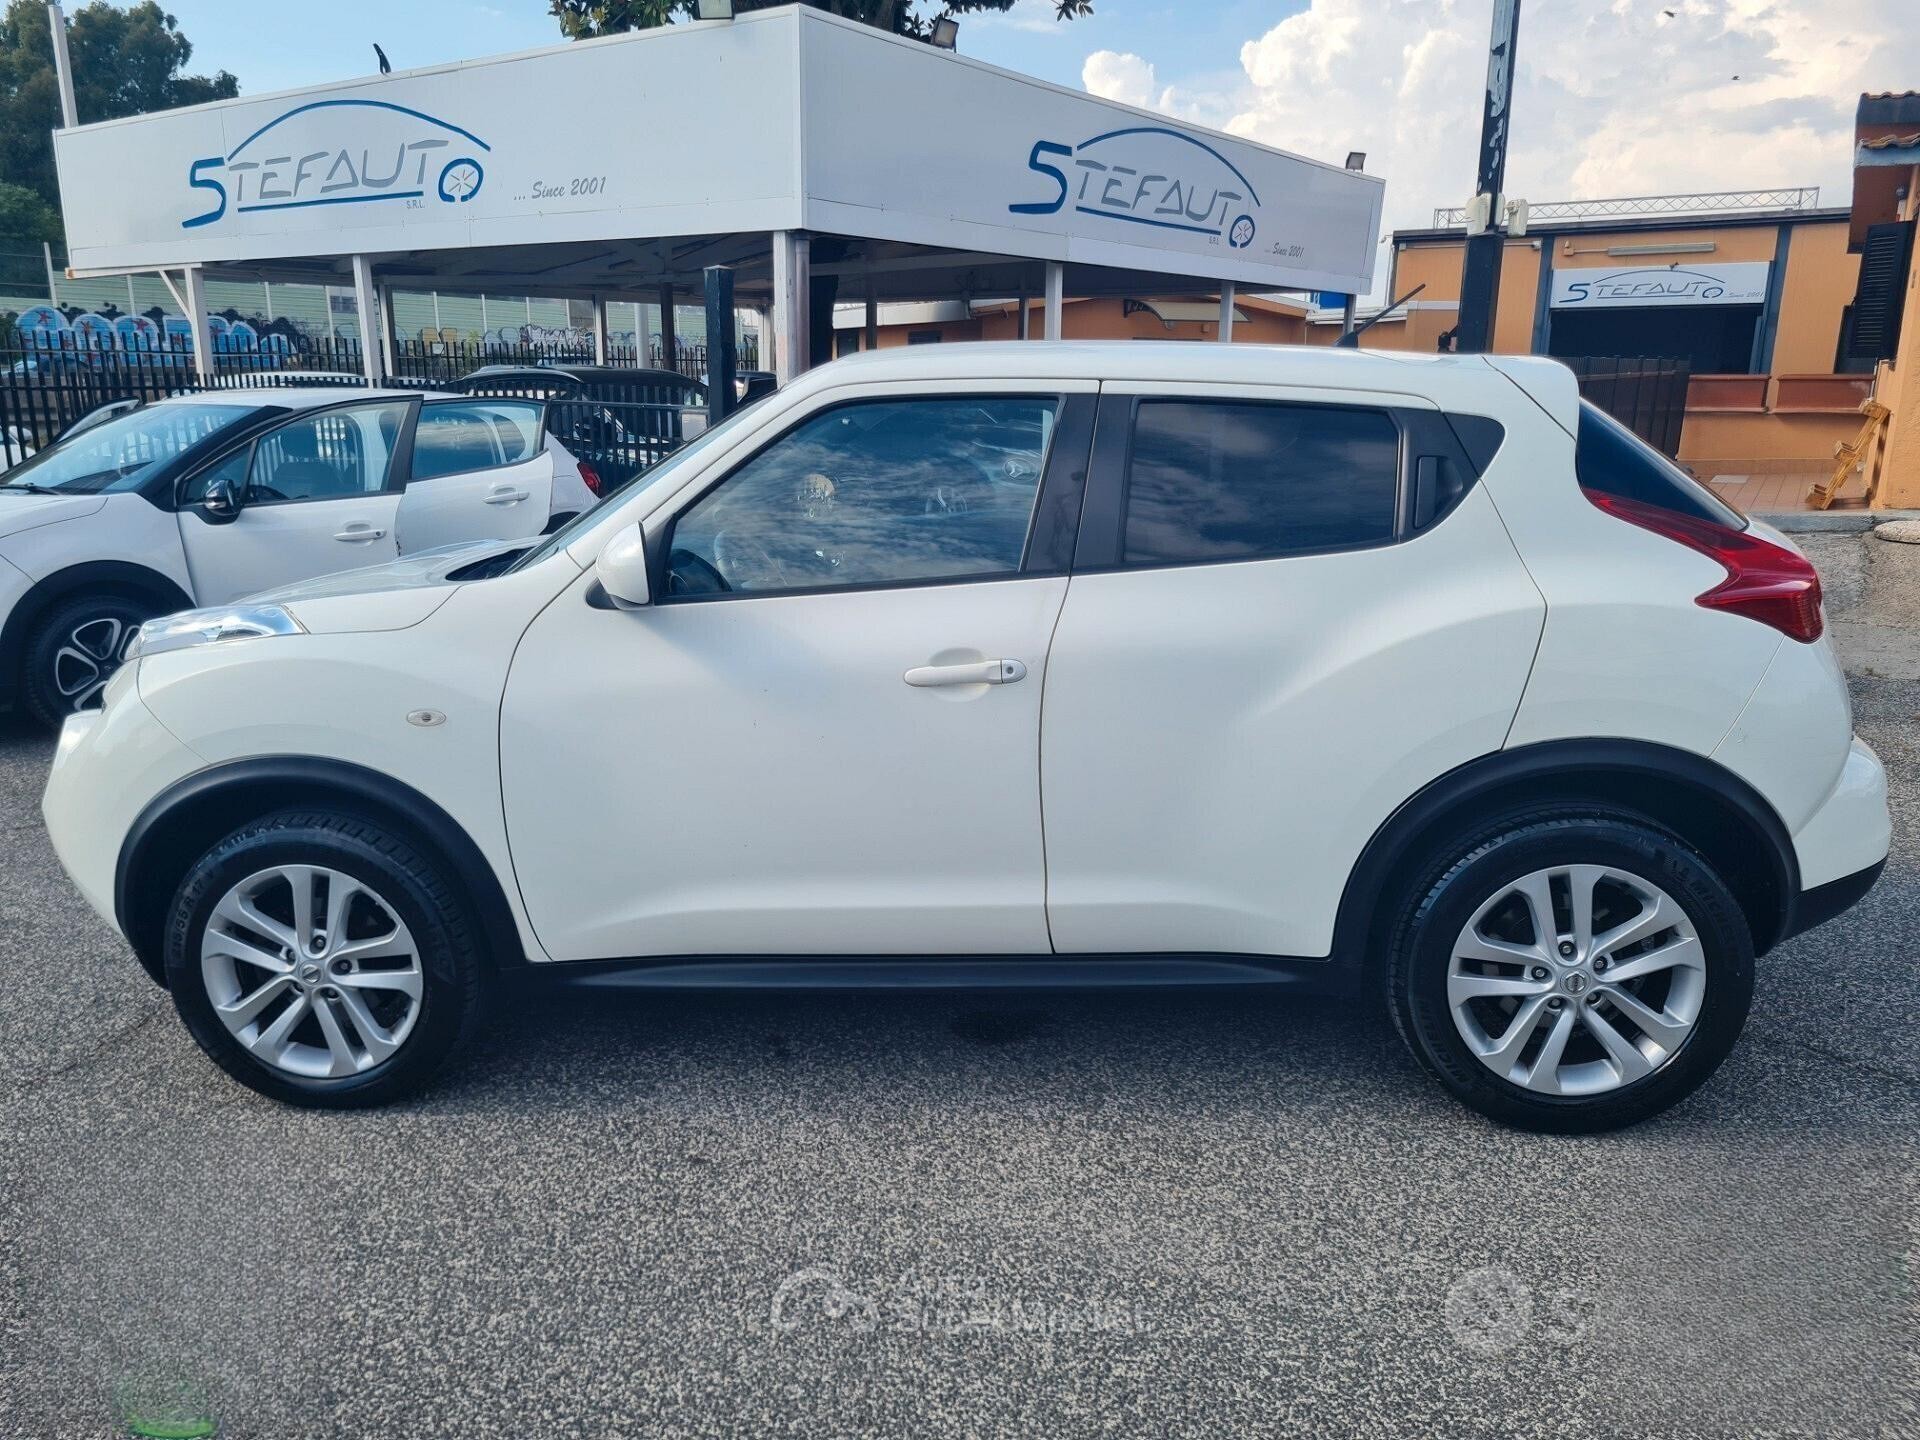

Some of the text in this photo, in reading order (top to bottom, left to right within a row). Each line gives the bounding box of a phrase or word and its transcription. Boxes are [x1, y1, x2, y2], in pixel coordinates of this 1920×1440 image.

[182, 139, 484, 228] STEFAUTO
[531, 180, 565, 200] Since
[570, 176, 606, 196] 2001
[1009, 140, 1256, 249] STEFAUTO
[1559, 282, 1723, 303] STEFAUTO
